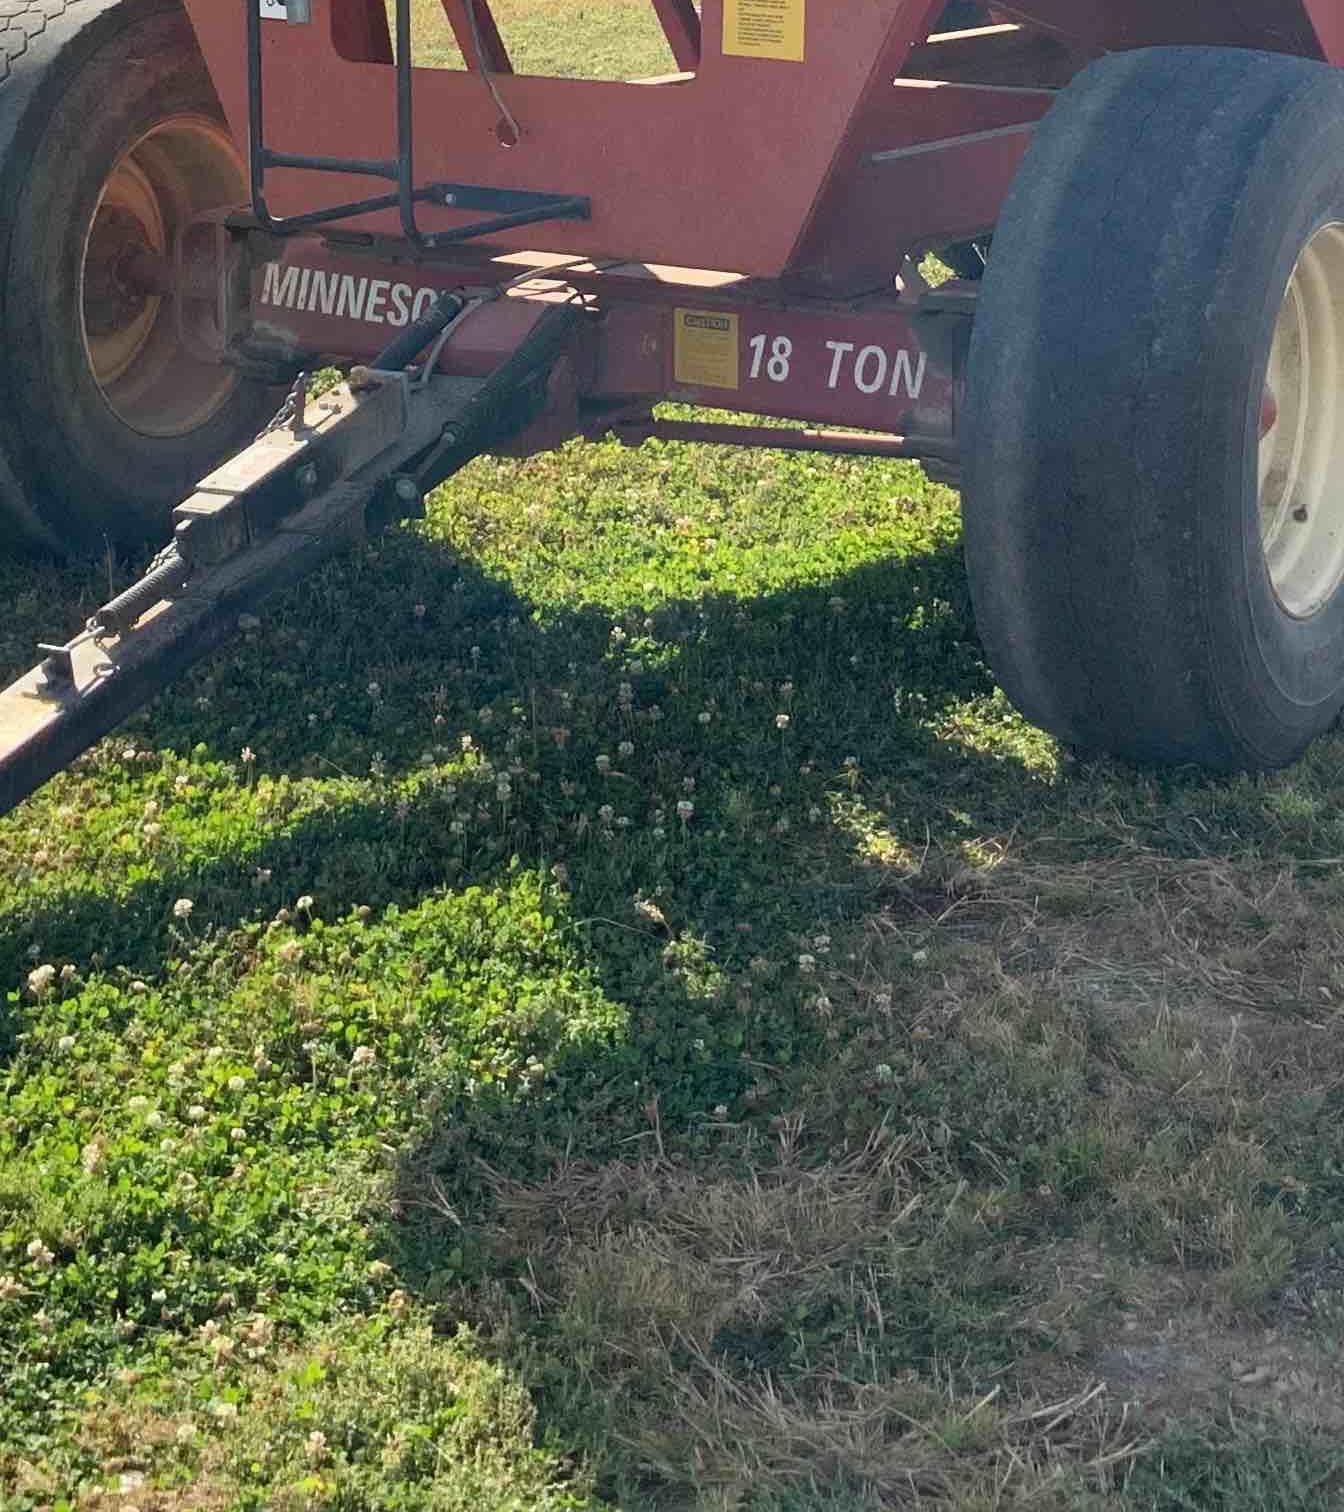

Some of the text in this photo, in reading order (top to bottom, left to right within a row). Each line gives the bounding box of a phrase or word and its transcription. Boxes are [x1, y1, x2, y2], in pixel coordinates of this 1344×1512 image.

[260, 262, 444, 327] MINNESO
[749, 334, 793, 382] 18
[825, 340, 928, 400] TON
